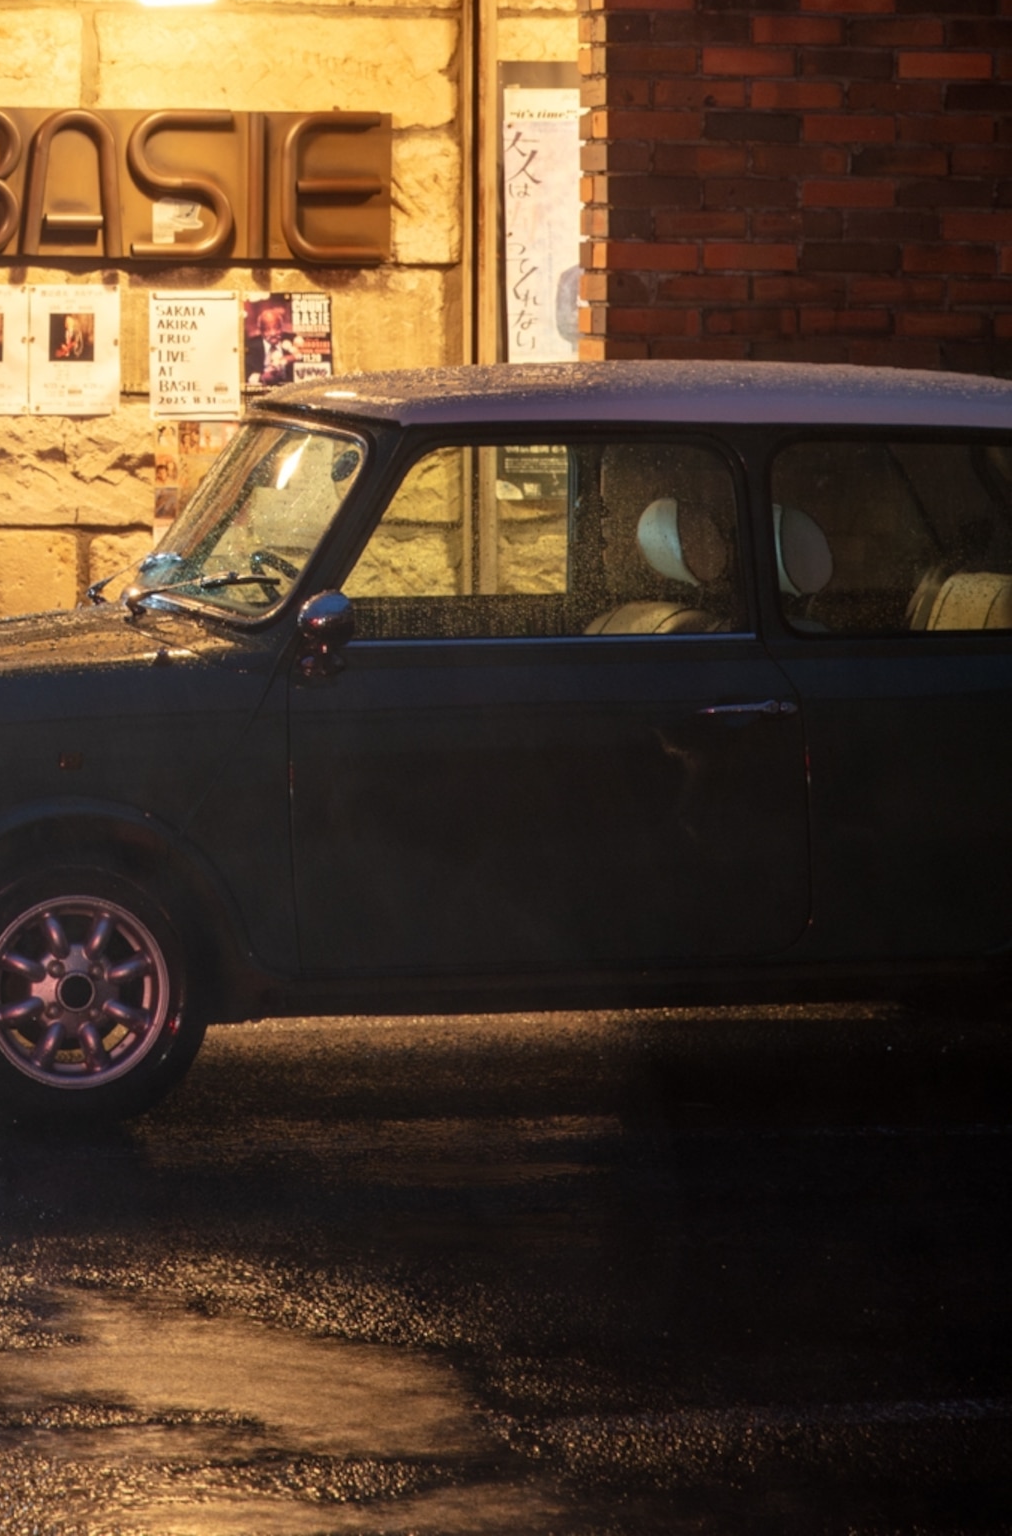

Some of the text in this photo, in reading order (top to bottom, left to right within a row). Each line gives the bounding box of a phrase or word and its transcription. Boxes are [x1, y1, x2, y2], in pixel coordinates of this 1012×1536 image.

[155, 305, 206, 317] SAKATA
[157, 319, 198, 330] AKIRA
[159, 333, 191, 344] TRIO
[158, 349, 190, 363] LIVE
[158, 365, 173, 377] AT
[159, 380, 201, 393] BASIE
